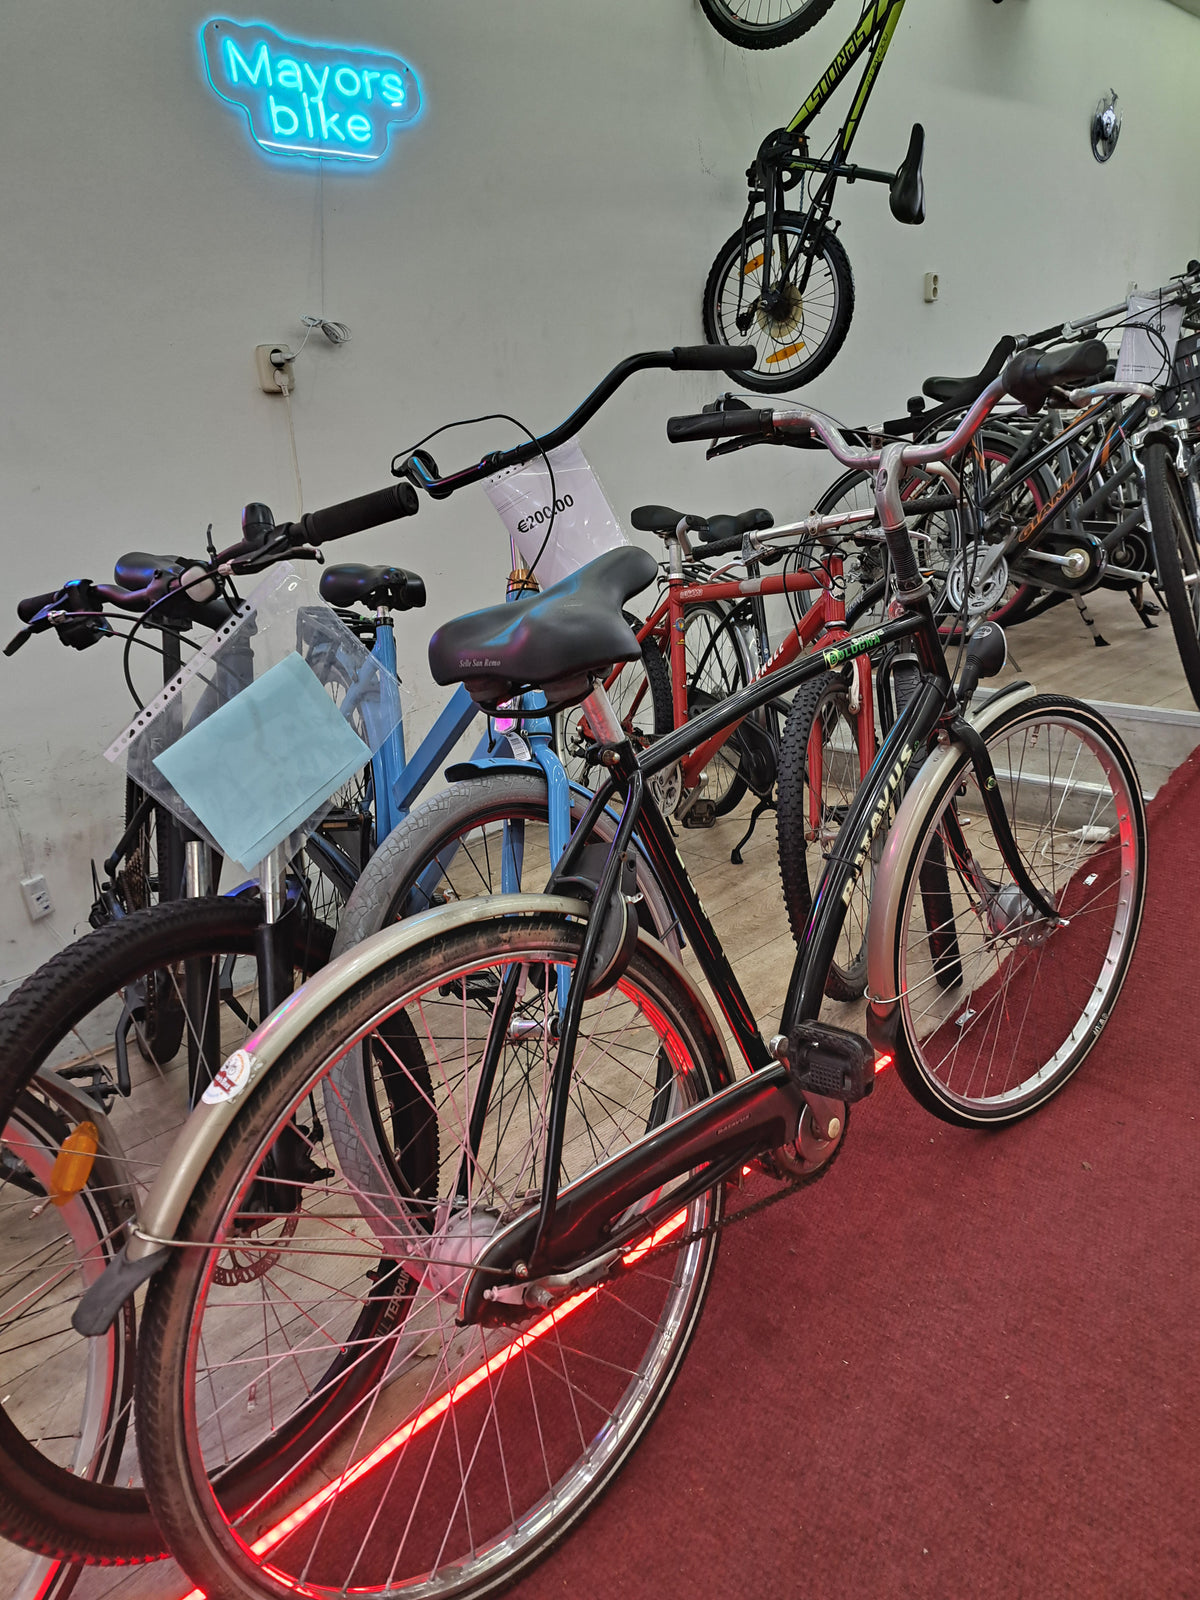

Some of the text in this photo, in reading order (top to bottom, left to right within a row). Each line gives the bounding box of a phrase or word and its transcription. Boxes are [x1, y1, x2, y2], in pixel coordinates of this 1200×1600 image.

[225, 38, 406, 104] Mayors
[268, 91, 372, 142] bike
[517, 494, 574, 533] €200.00
[1018, 469, 1078, 543] GIANT
[472, 658, 483, 668] San
[484, 658, 501, 668] Remo
[829, 634, 881, 665] BOLOGNA
[841, 743, 912, 907] BATAVUS
